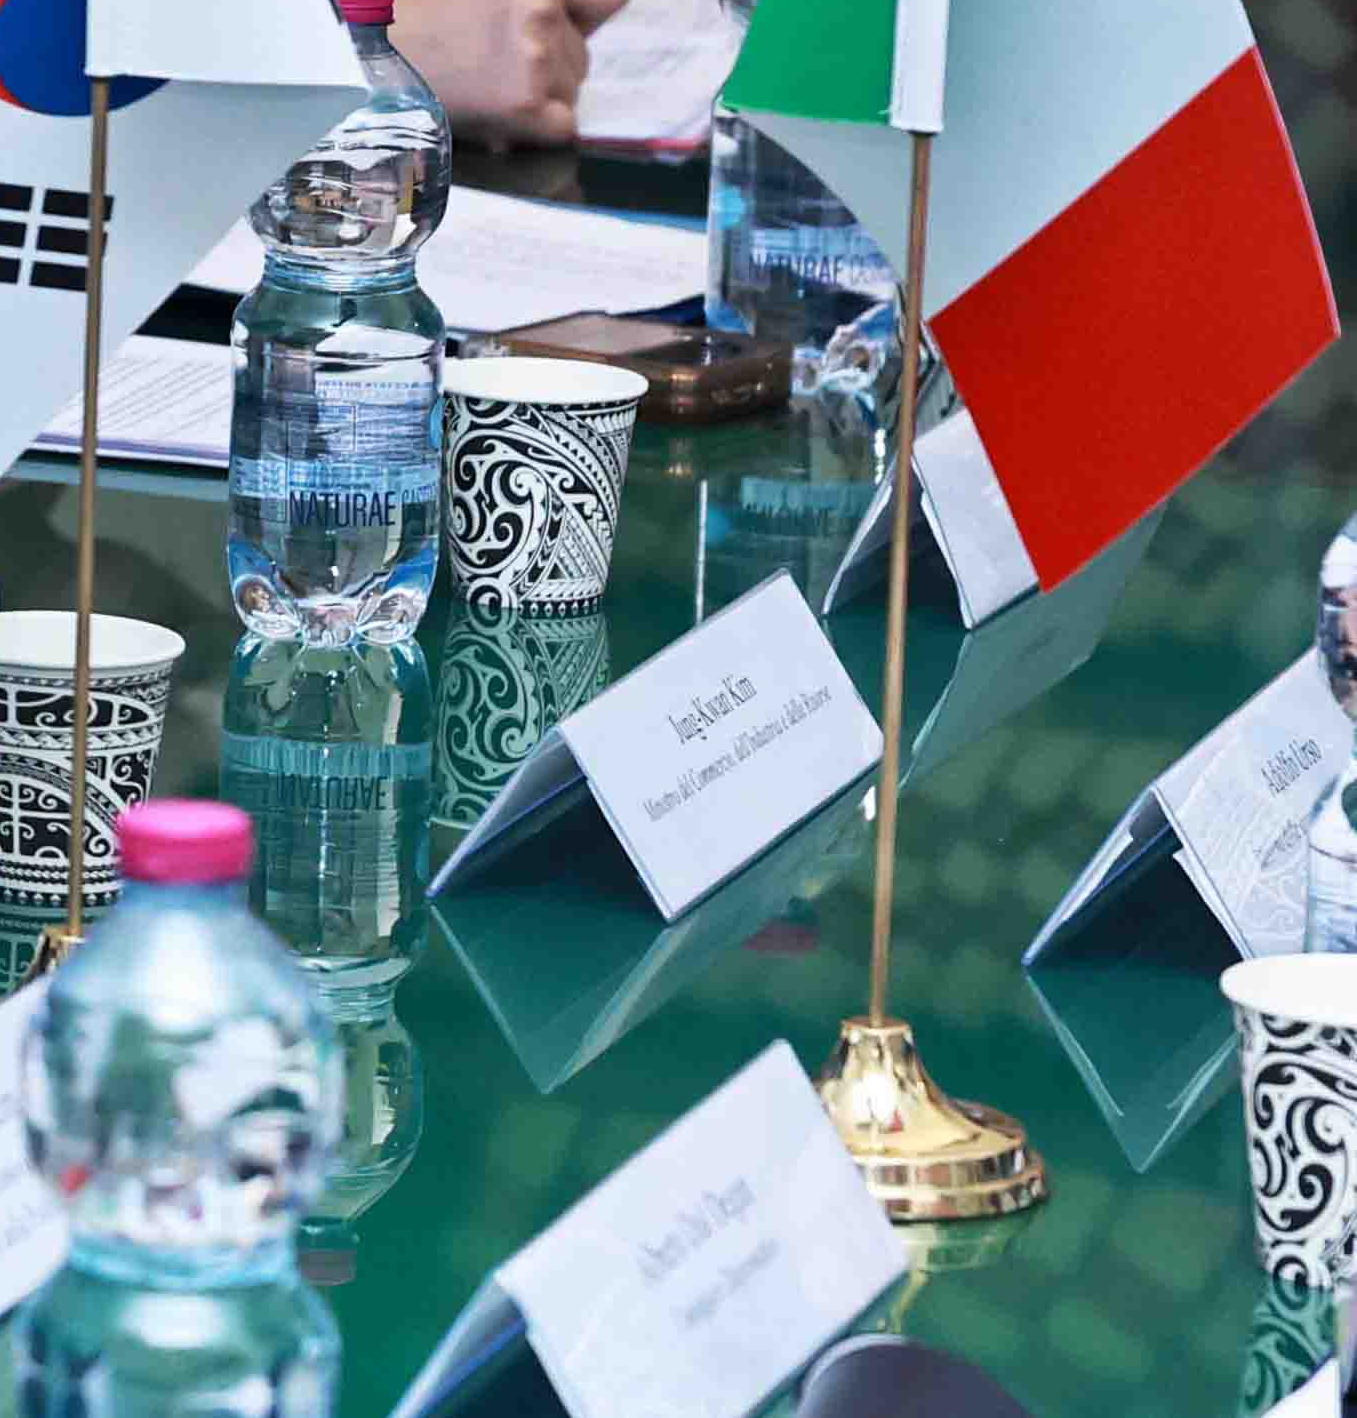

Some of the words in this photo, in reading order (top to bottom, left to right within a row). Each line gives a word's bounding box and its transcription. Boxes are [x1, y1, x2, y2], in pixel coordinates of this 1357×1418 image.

[289, 489, 396, 527] NATURAE
[667, 692, 735, 745] Jung-Kwan
[722, 674, 758, 707] Kim
